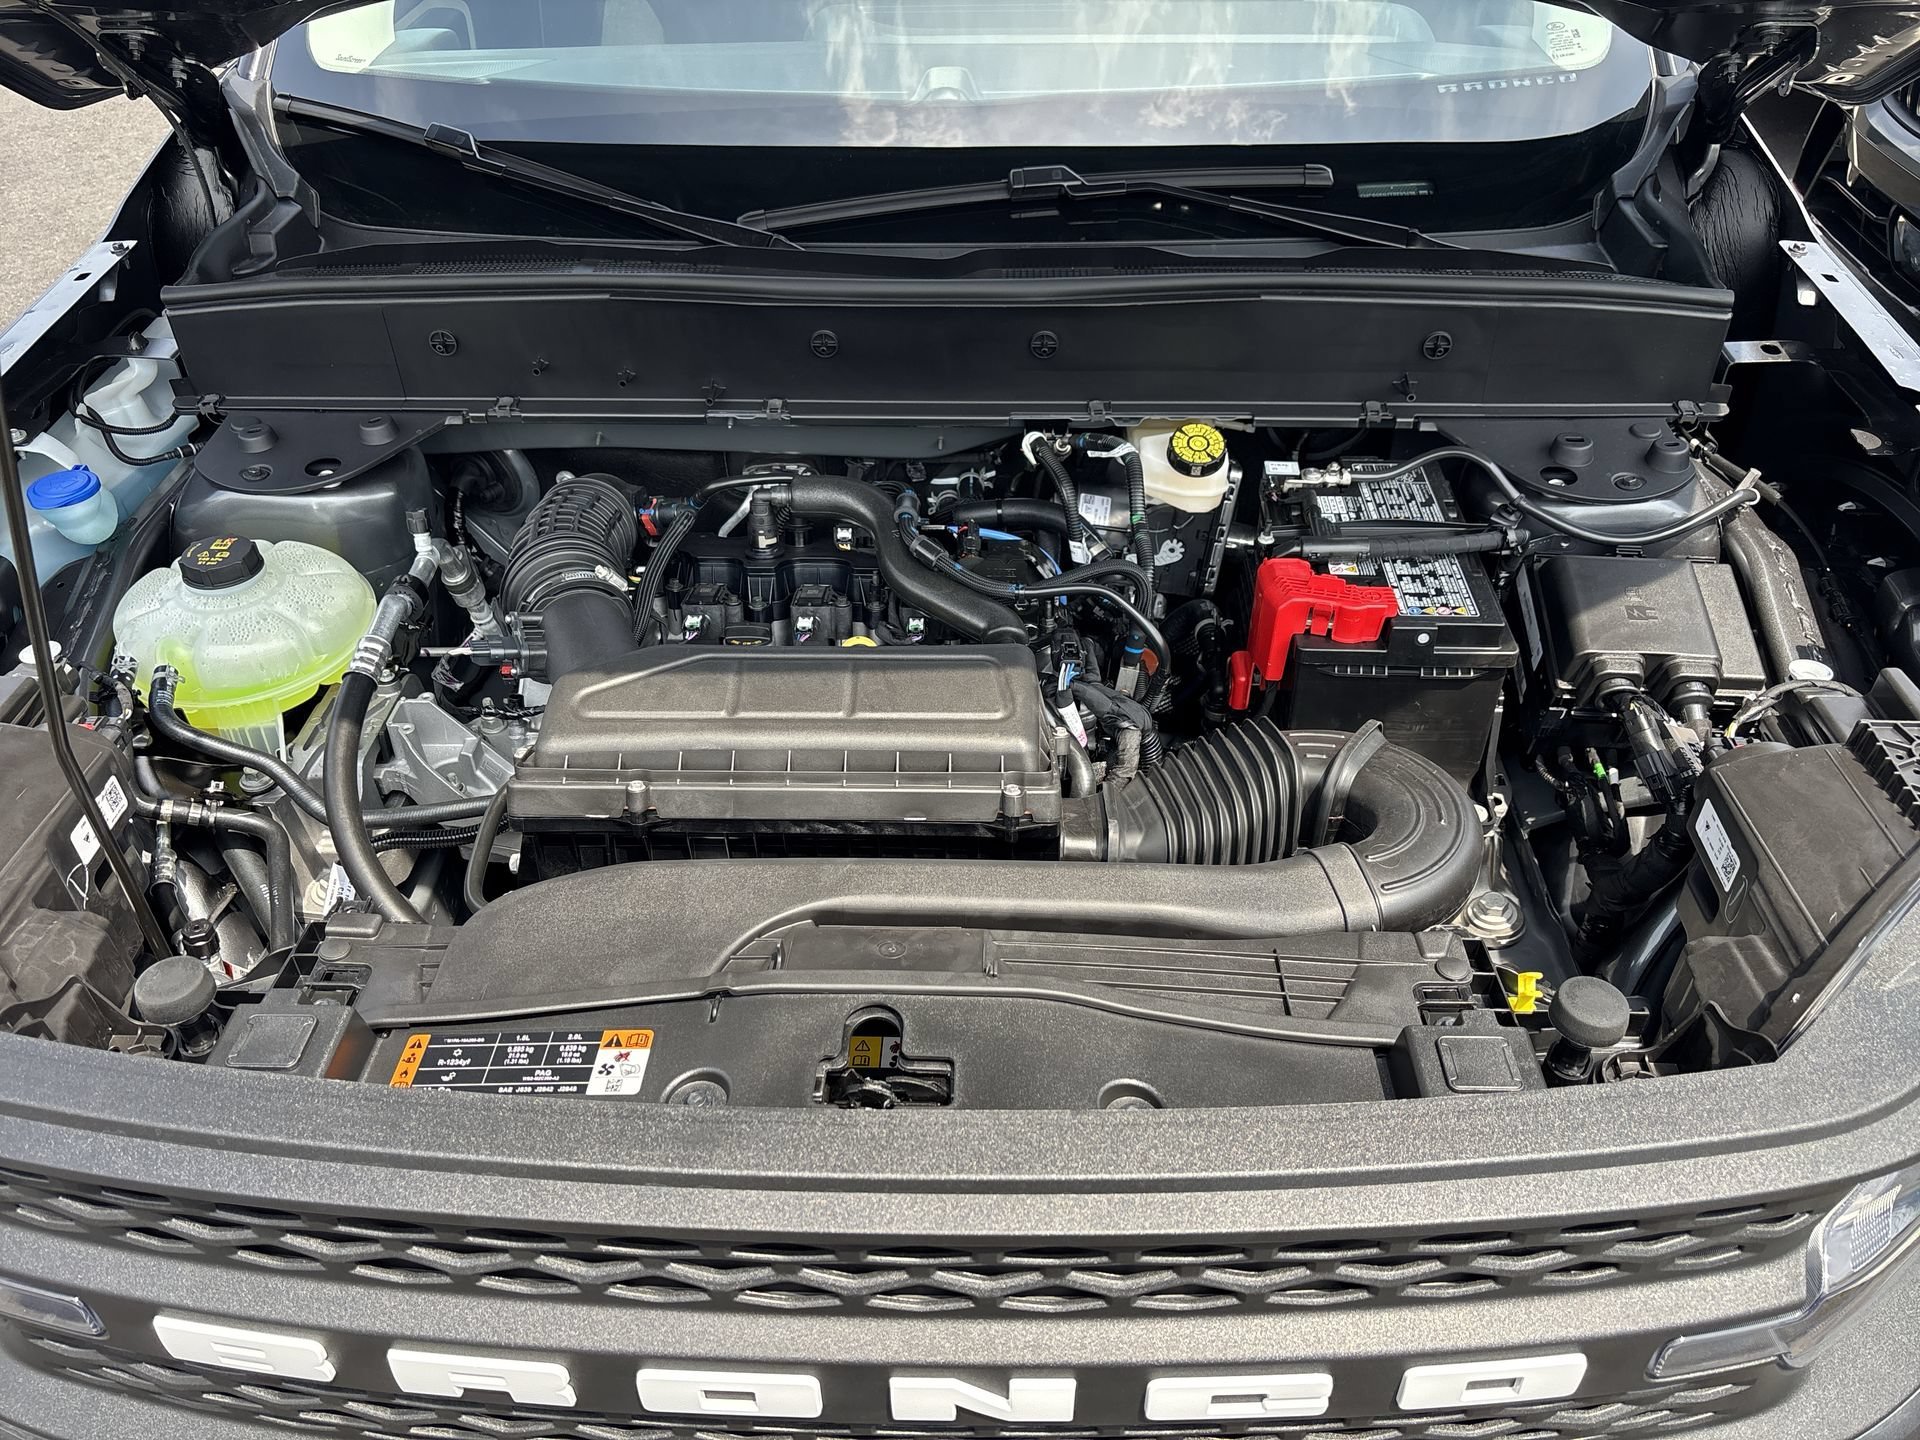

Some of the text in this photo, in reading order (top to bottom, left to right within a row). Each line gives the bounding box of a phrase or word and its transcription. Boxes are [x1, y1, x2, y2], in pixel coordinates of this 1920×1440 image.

[1437, 73, 1577, 93] BRONCO
[437, 1058, 471, 1067] R-1234yf
[153, 1314, 1588, 1421] BRONCO
